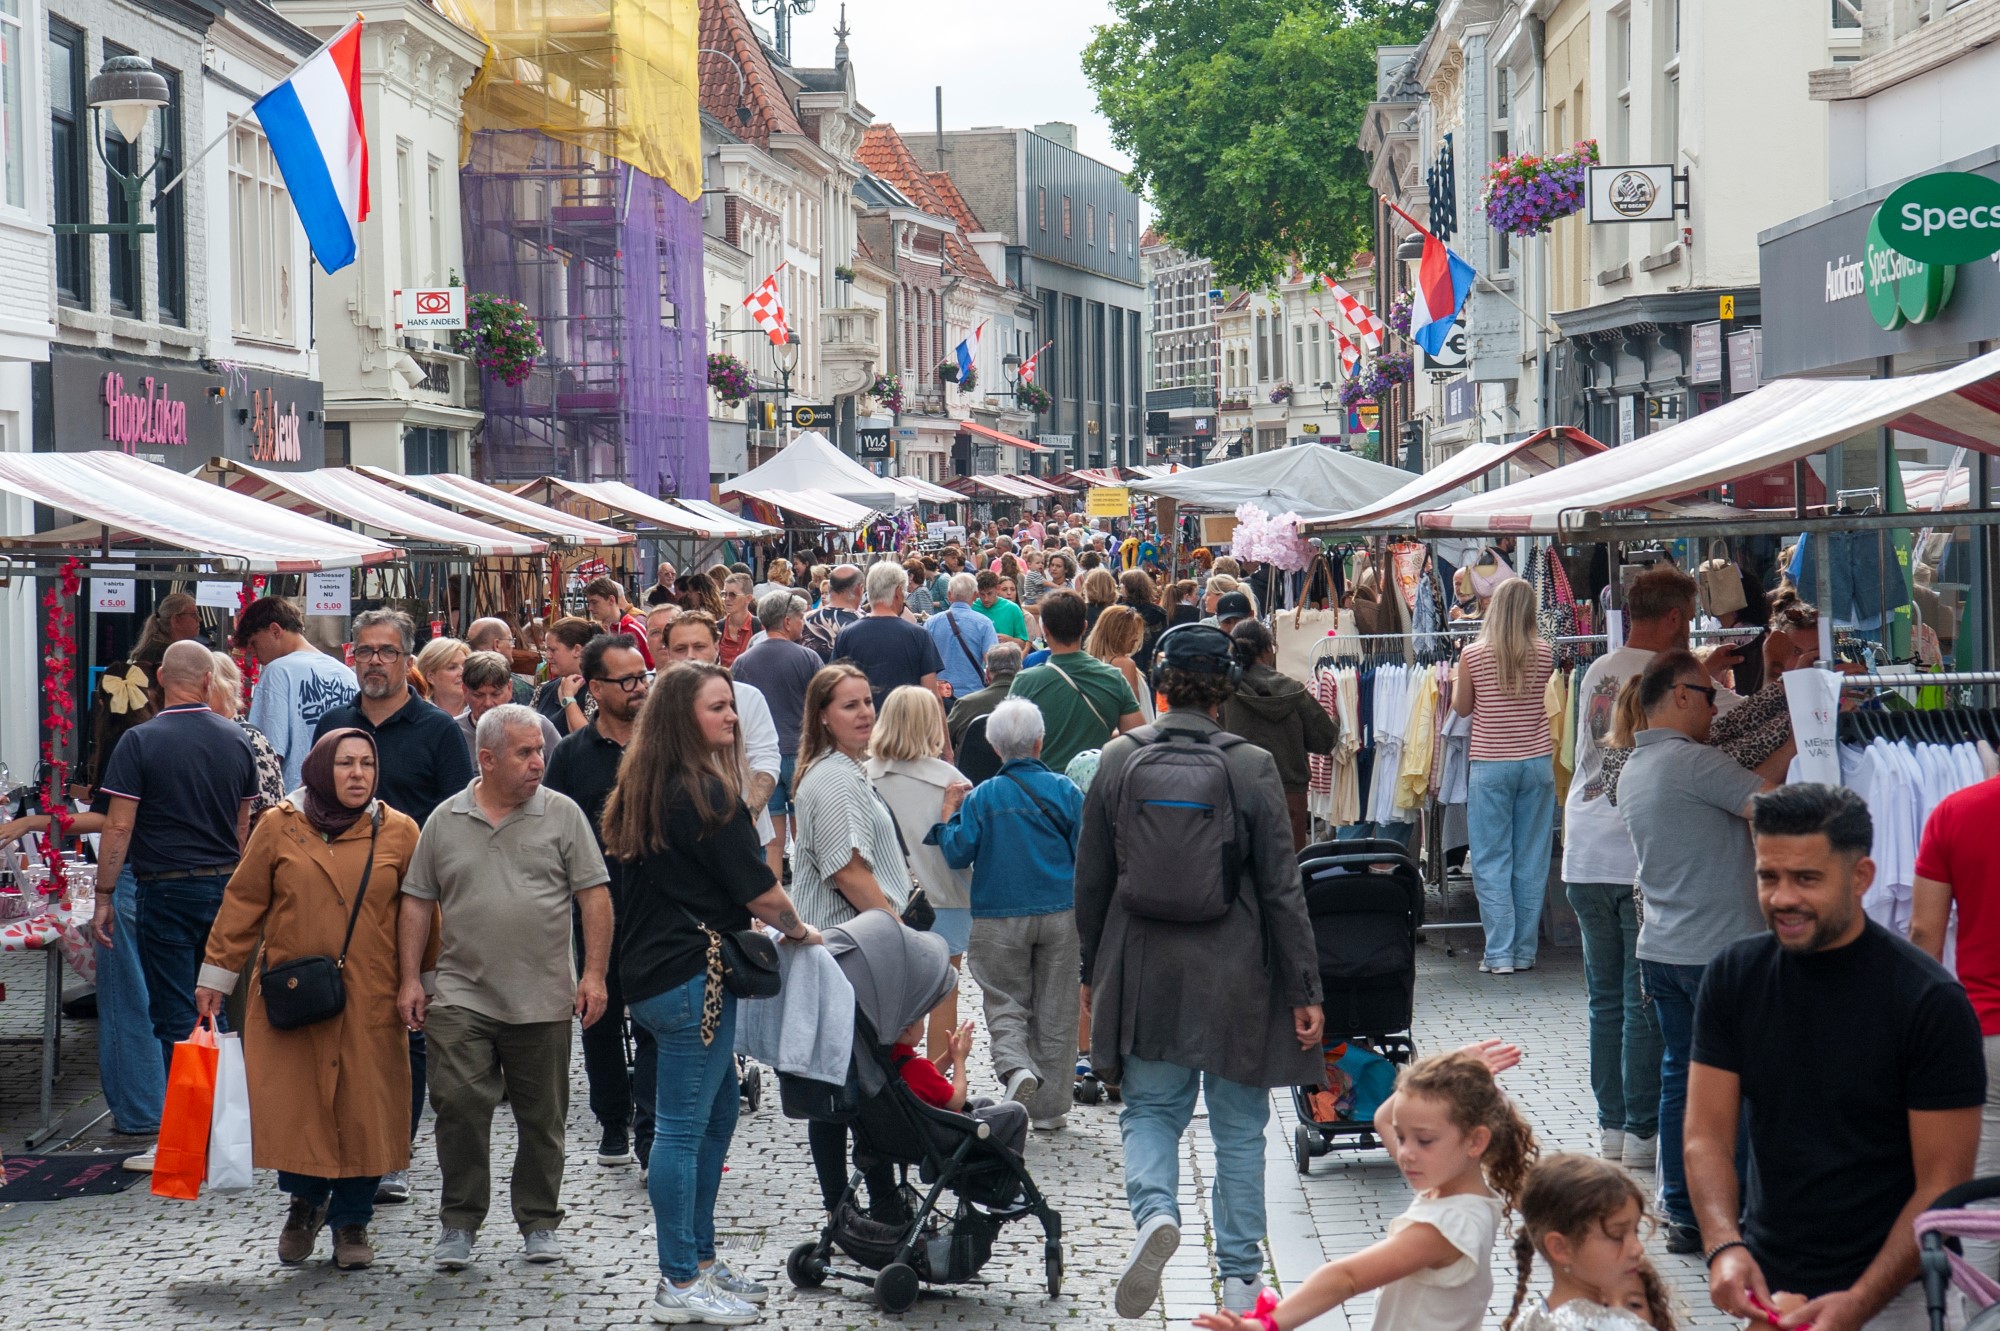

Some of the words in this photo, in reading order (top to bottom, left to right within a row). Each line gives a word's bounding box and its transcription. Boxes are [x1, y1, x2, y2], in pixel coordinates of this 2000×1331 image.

[1825, 254, 1865, 303] Audiciens
[106, 371, 188, 457] HippeZaken
[107, 599, 126, 607] 5,00
[323, 602, 342, 610] 5,00
[907, 1214, 928, 1248] hamilton
